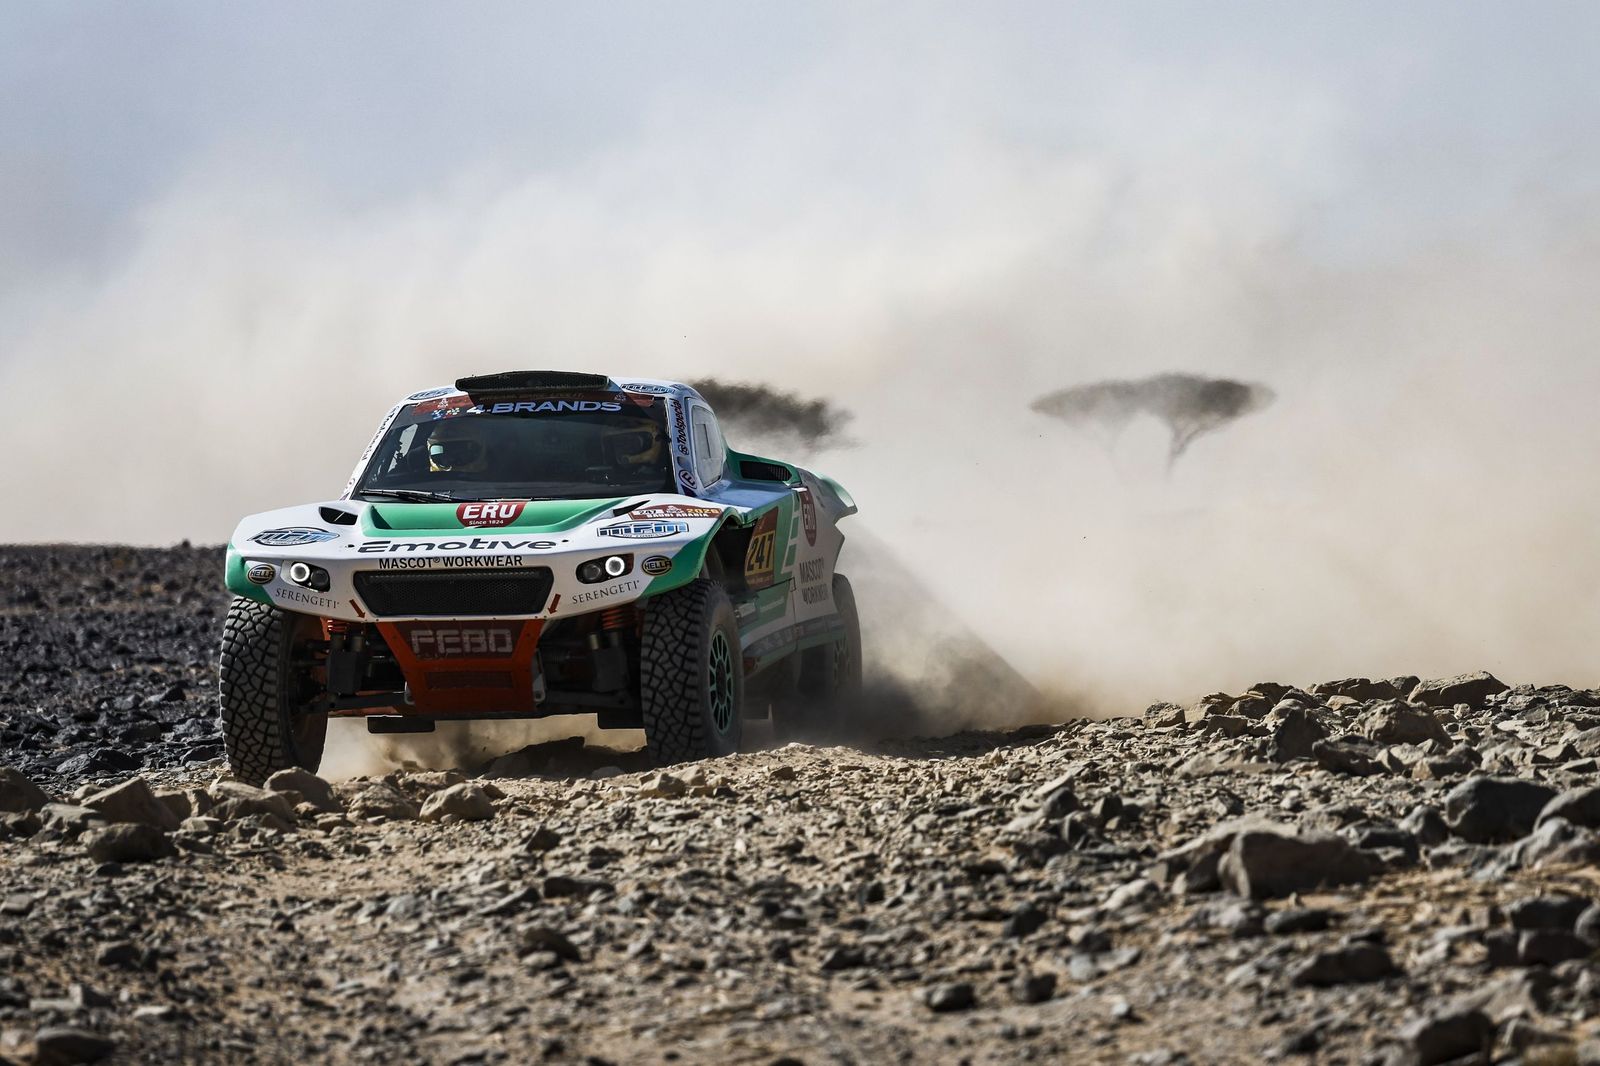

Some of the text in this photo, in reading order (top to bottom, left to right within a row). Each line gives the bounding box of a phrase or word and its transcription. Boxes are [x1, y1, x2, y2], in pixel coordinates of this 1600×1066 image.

[462, 503, 518, 519] ERU
[357, 538, 557, 554] Emotive
[746, 532, 775, 573] 247
[443, 554, 523, 567] WORKWEAR
[644, 559, 673, 571] HELLA
[250, 568, 276, 579] HELLA
[410, 629, 513, 654] FEBO
